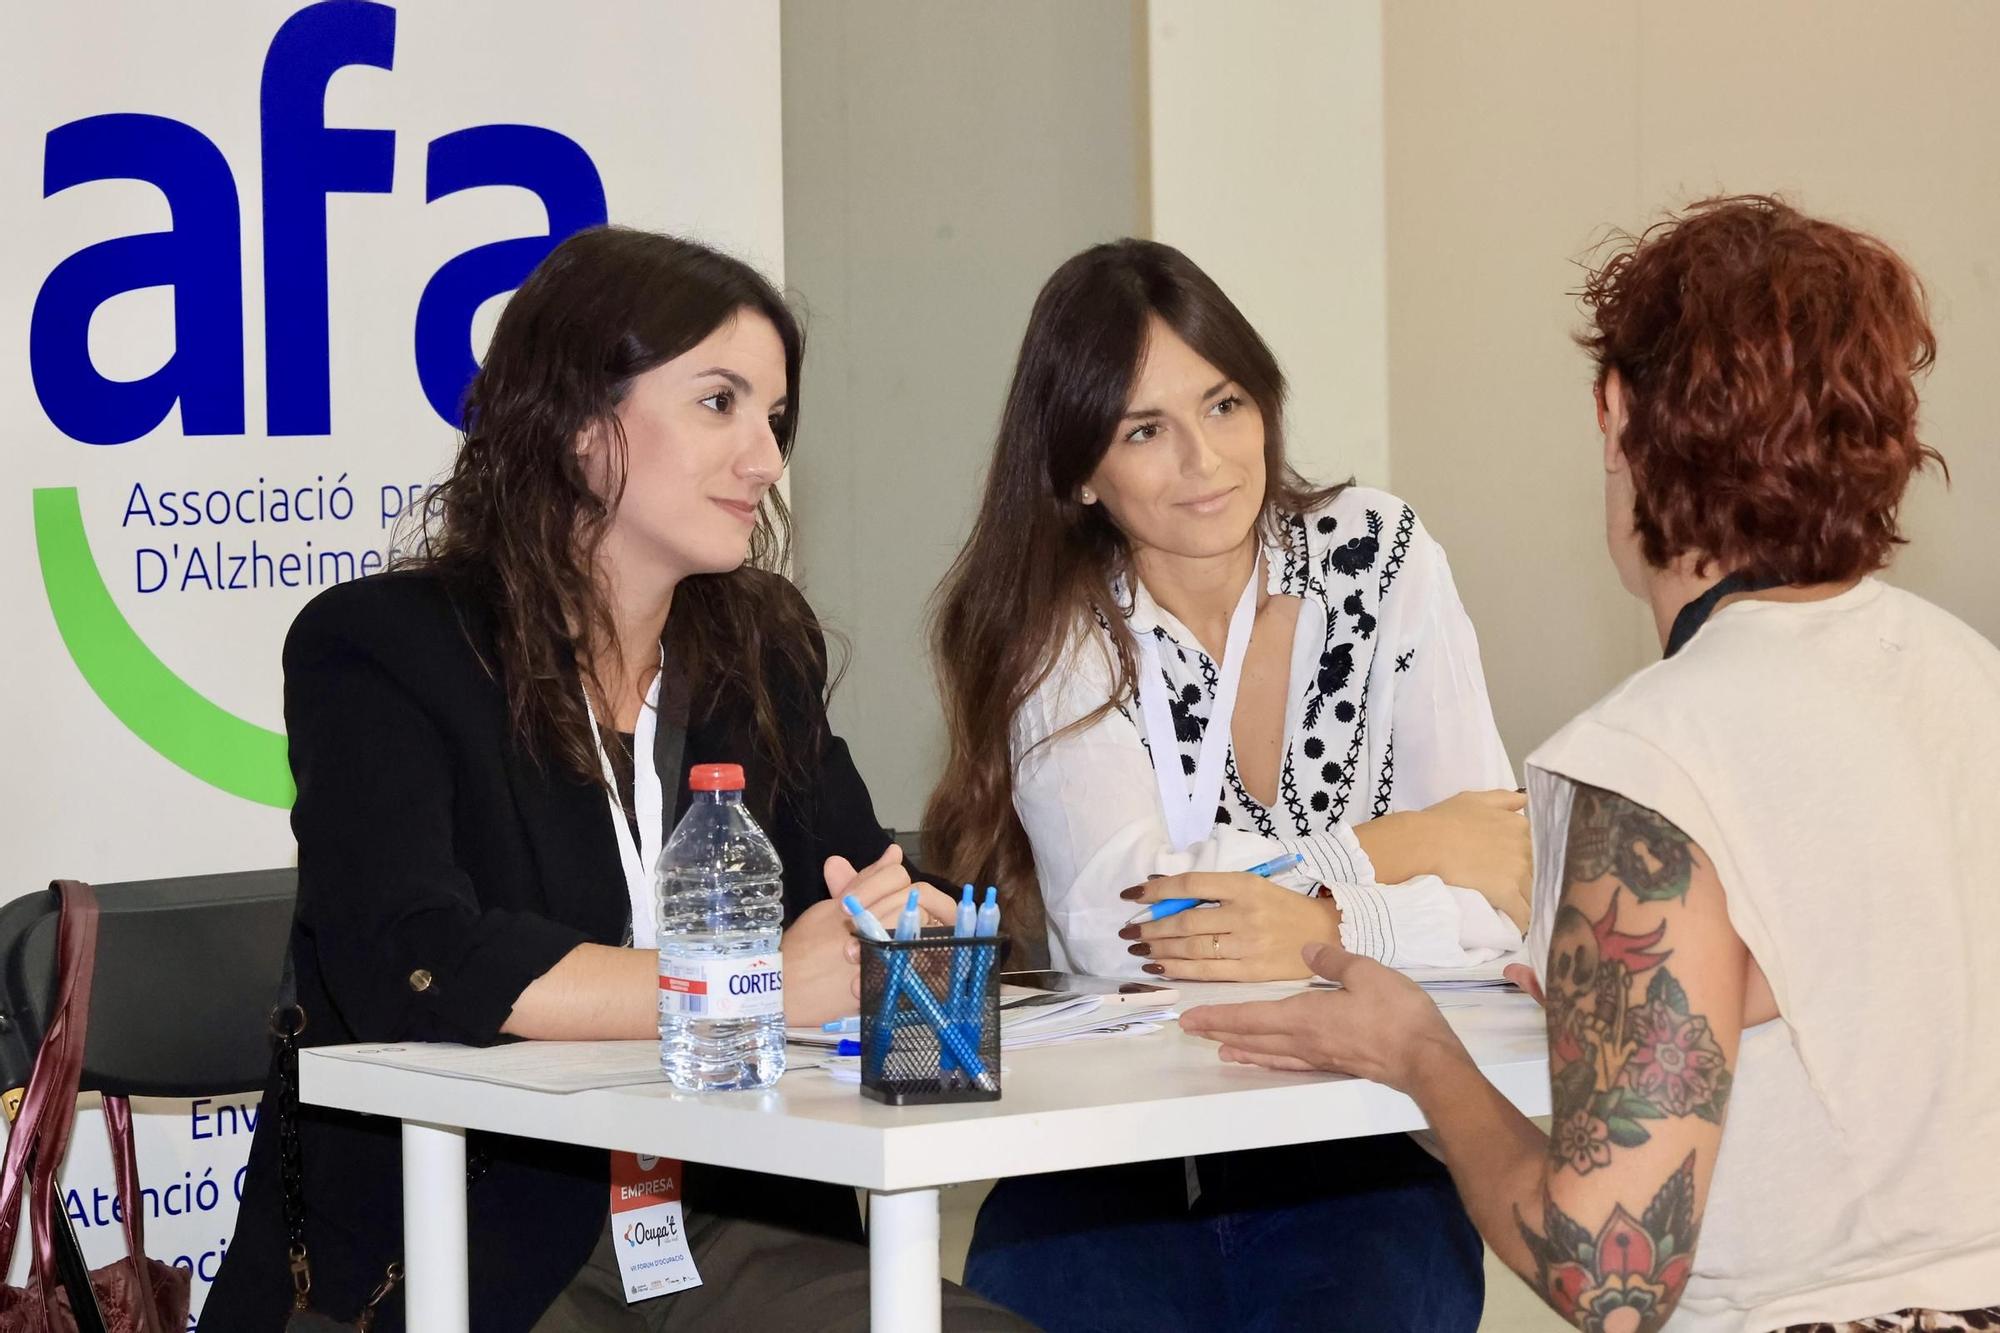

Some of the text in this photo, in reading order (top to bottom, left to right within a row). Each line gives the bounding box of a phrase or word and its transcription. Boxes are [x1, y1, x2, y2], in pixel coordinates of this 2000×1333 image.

[30, 0, 609, 445] afa
[122, 472, 354, 527] Associació
[729, 970, 783, 996] CORTES
[621, 1177, 674, 1200] EMPRESA
[635, 1215, 677, 1247] Ocupa't
